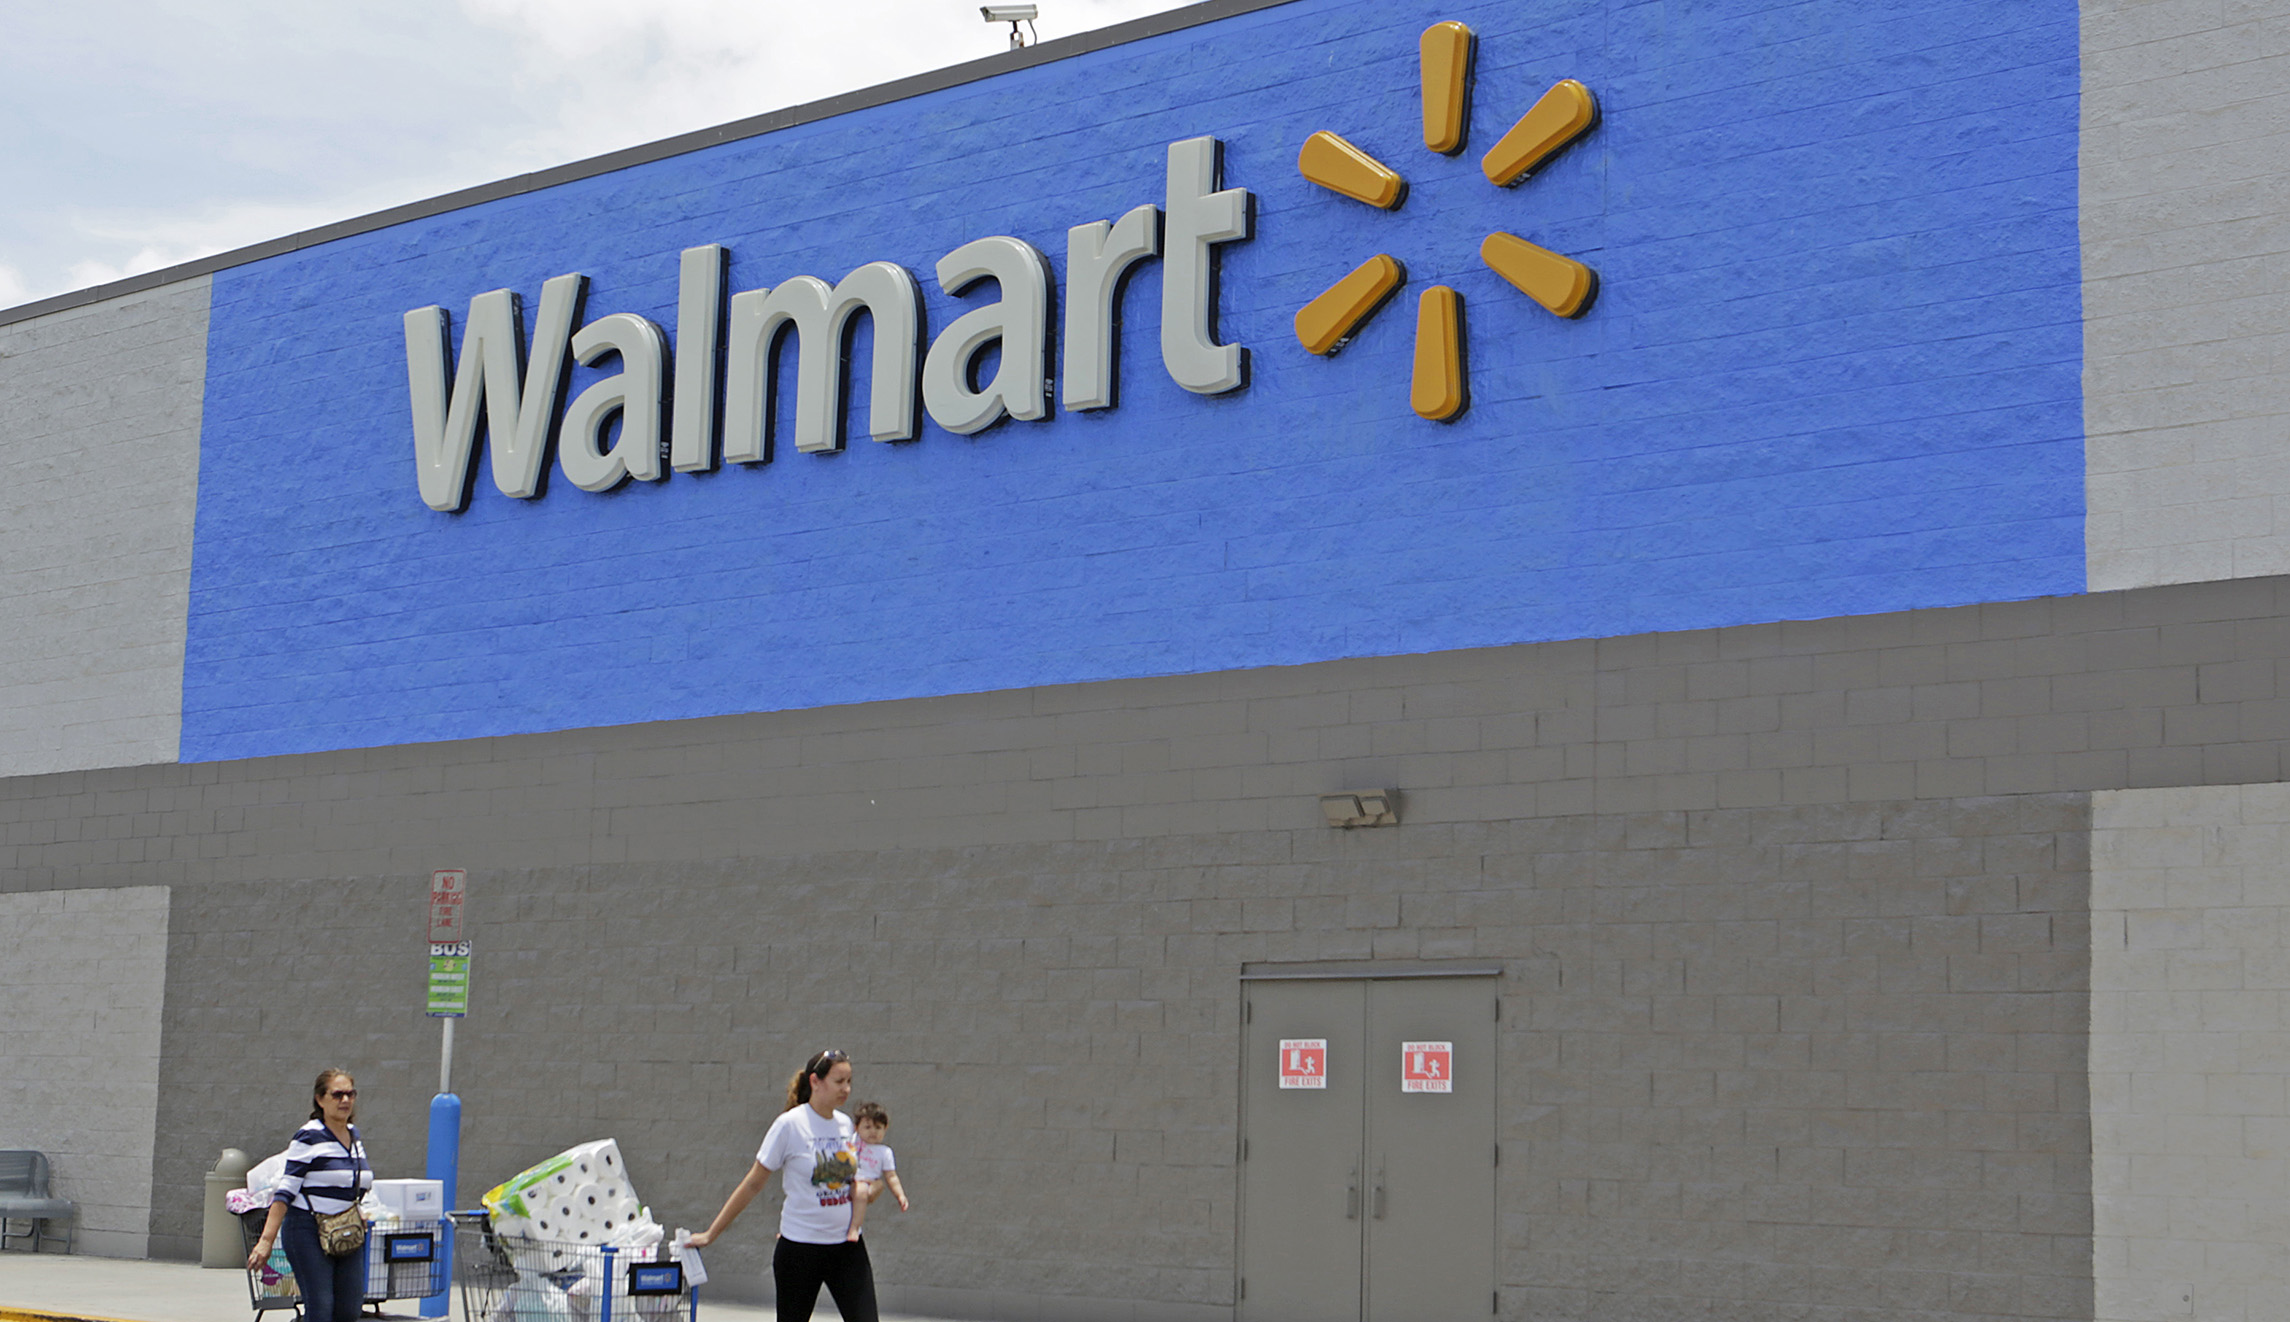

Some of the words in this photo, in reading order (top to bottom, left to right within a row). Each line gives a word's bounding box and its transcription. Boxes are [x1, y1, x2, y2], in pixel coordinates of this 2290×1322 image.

[404, 135, 1252, 513] Walmart
[442, 876, 455, 890] NO
[436, 917, 454, 927] LANE
[430, 942, 469, 956] BUS
[1285, 1077, 1299, 1086] FIRE
[1302, 1076, 1321, 1086] EXITS
[1408, 1080, 1423, 1090] FIRE
[1426, 1080, 1447, 1090] EXITS
